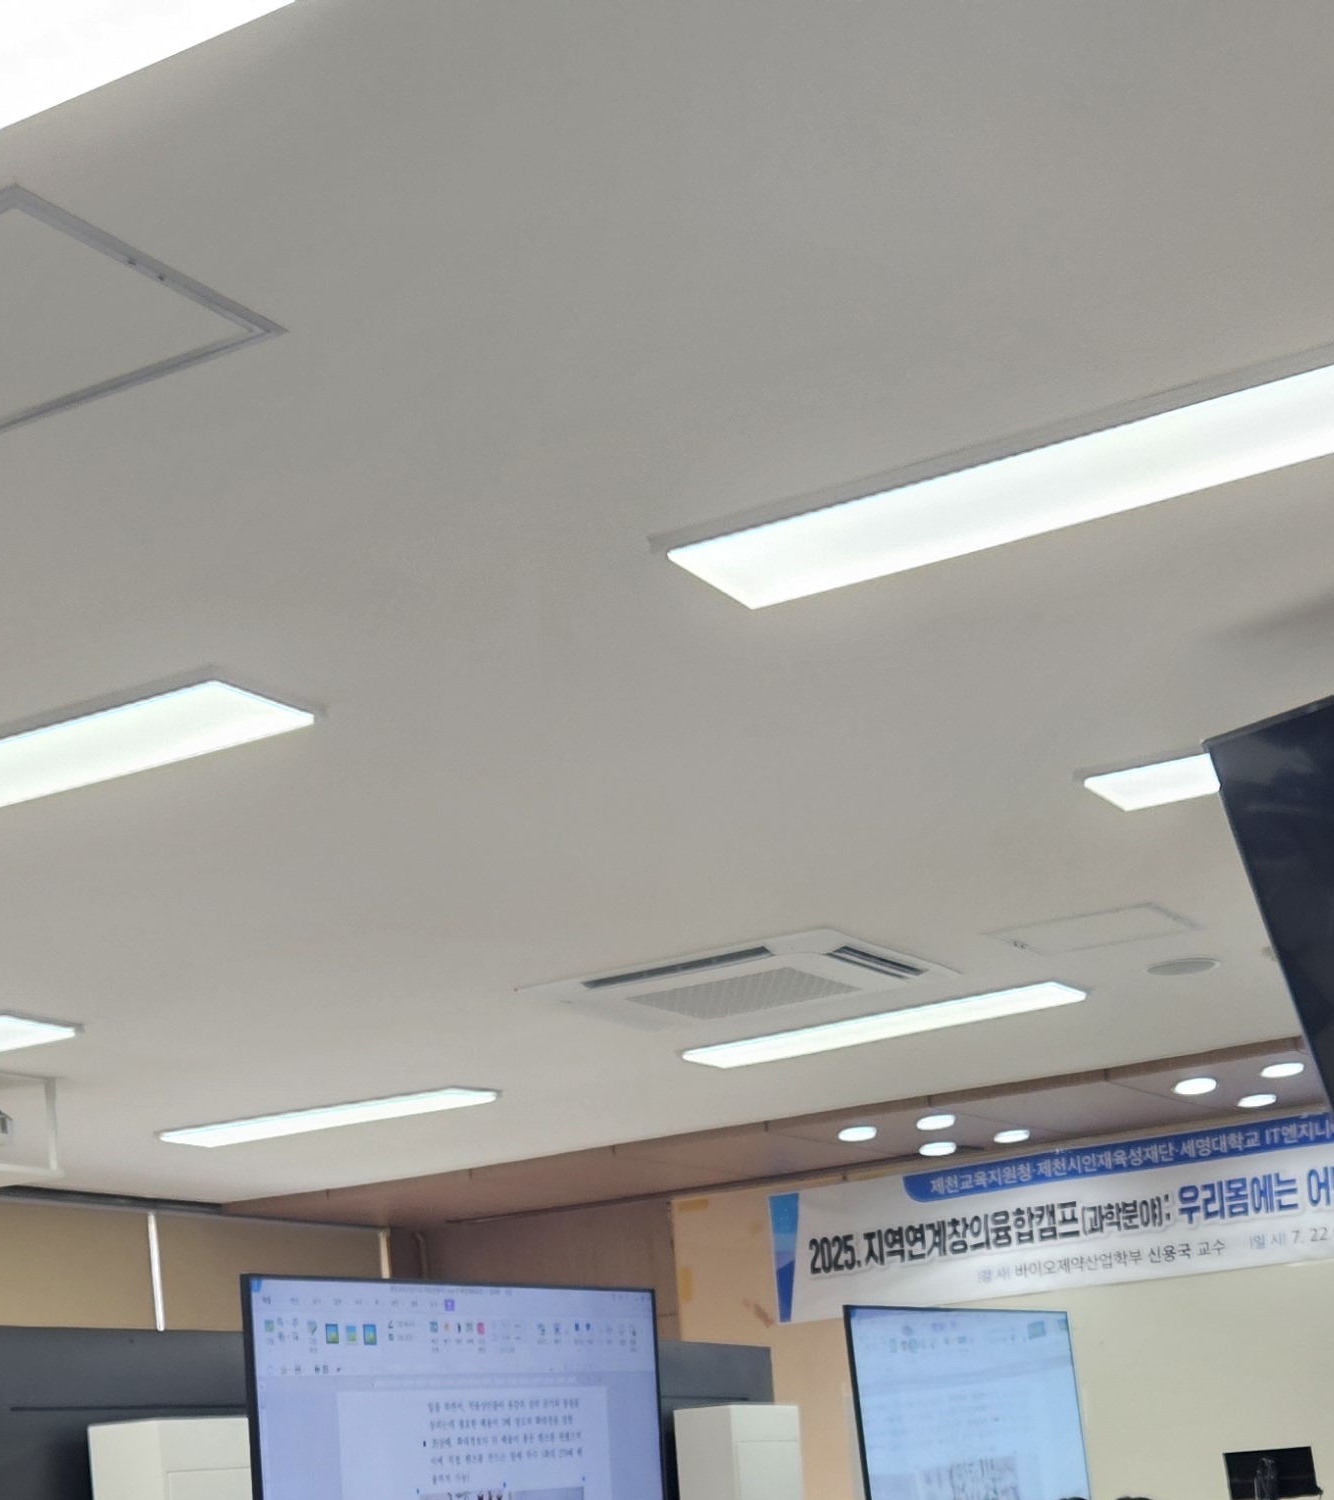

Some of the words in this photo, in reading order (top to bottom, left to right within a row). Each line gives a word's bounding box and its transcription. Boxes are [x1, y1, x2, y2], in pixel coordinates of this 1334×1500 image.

[1178, 1173, 1299, 1225] 우리몸에는
[1014, 1248, 1143, 1278] 바이오제약산업학부
[1148, 1242, 1192, 1264] 신용국
[1196, 1238, 1227, 1257] 교수
